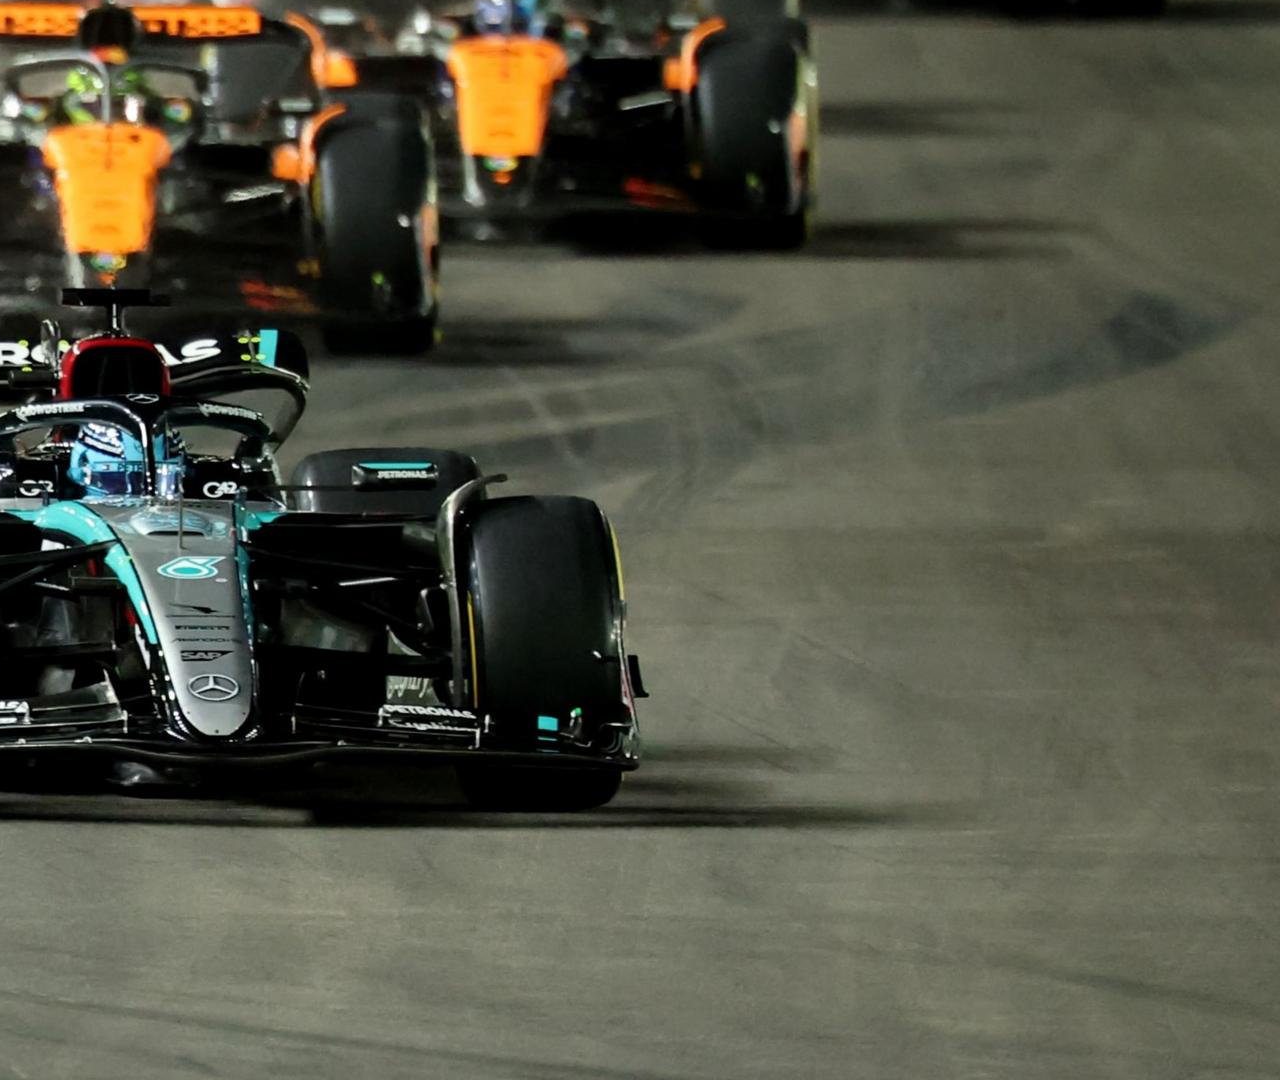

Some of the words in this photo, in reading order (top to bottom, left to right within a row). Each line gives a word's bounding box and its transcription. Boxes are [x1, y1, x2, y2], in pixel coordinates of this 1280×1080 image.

[377, 470, 428, 480] PETRONAS
[202, 481, 239, 498] G42
[383, 704, 477, 719] PETRONAS
